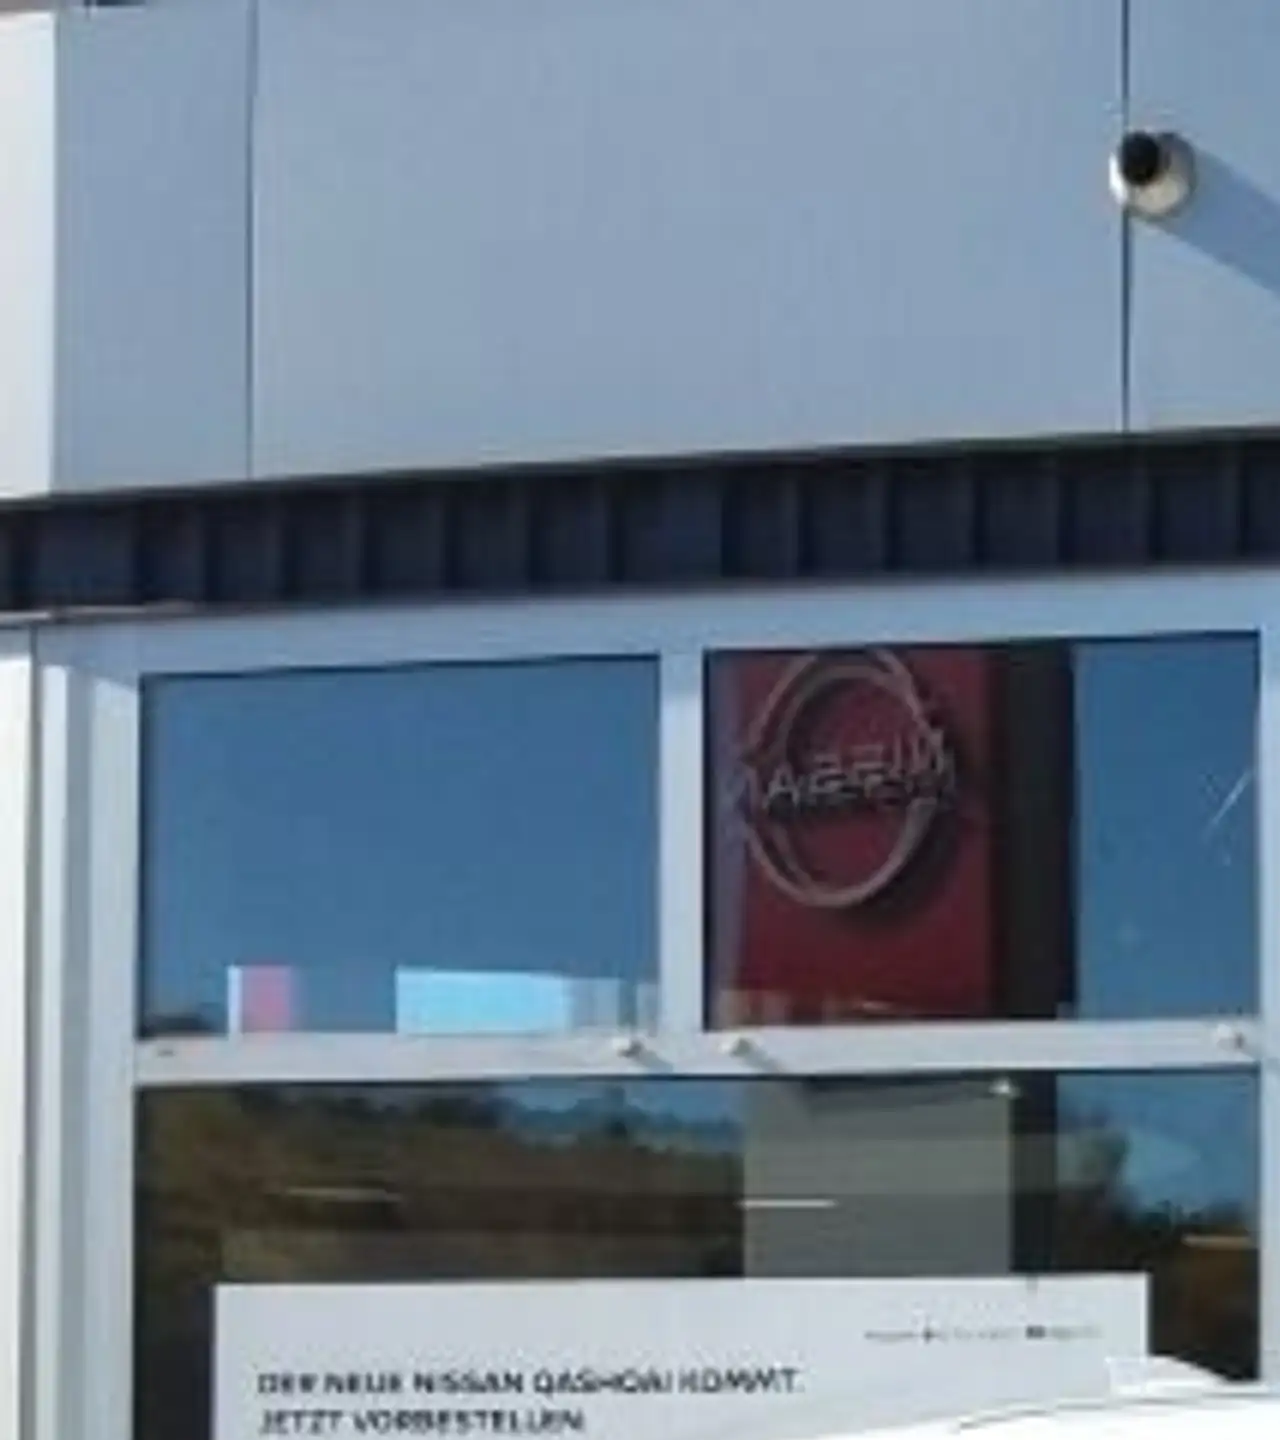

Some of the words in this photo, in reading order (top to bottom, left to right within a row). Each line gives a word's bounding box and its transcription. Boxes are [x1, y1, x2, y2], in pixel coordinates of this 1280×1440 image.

[257, 1372, 319, 1395] DER
[323, 1372, 403, 1395] NEUE
[412, 1369, 525, 1395] NISSAN
[533, 1367, 674, 1399] QASHQAI
[258, 1409, 344, 1435] JETZT
